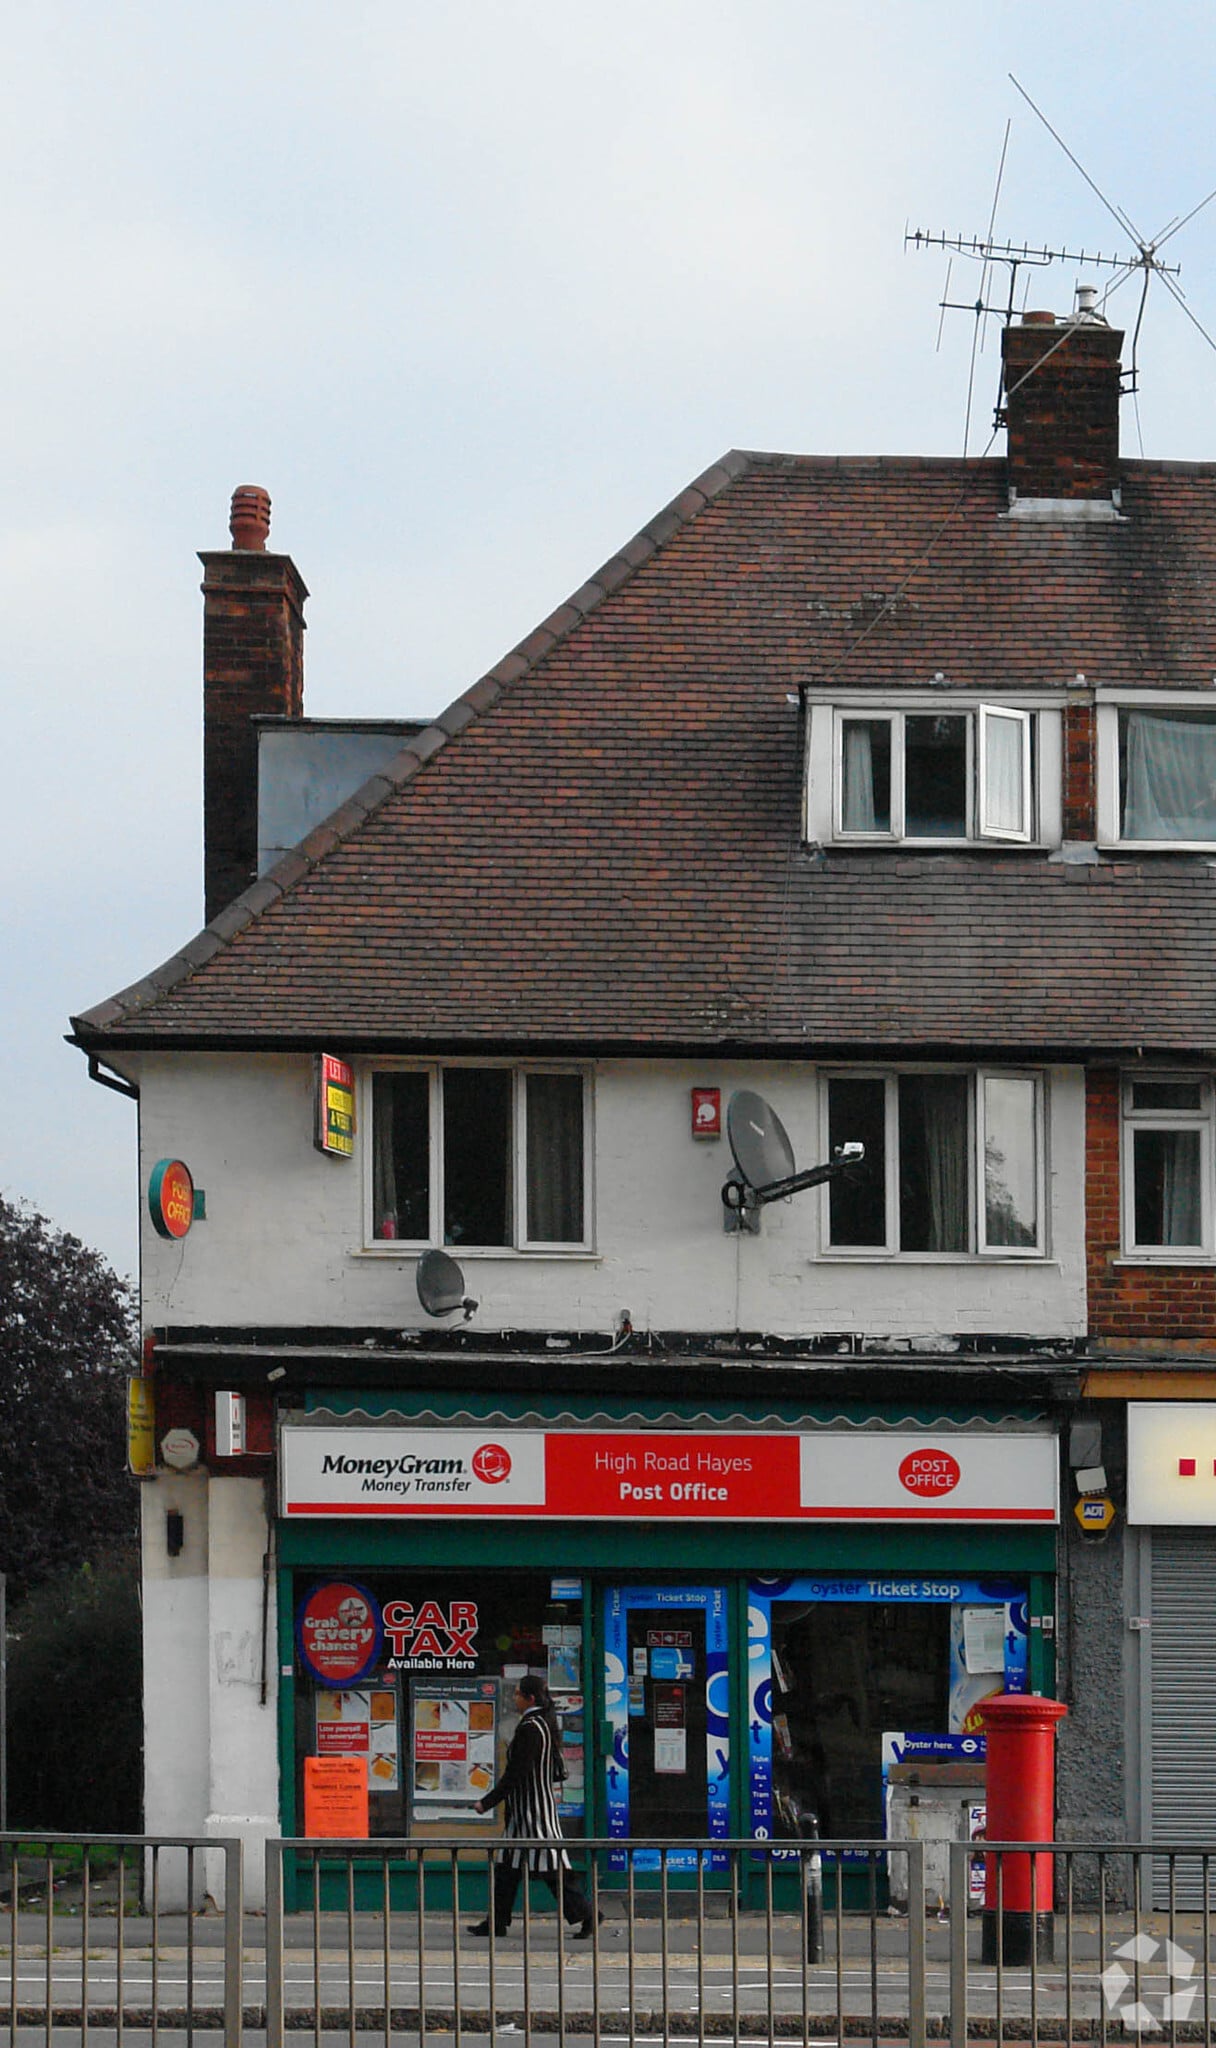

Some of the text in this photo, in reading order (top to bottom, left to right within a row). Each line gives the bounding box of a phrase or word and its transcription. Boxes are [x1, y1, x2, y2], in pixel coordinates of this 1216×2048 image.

[321, 1455, 463, 1478] MoneyGram
[595, 1452, 753, 1475] High Road Hayes
[912, 1459, 950, 1472] POST
[361, 1478, 472, 1495] Money Transfer
[905, 1474, 954, 1487] OFFICE
[620, 1482, 729, 1500] Post Office
[1083, 1504, 1105, 1518] ADT
[811, 1581, 960, 1599] oyster Ticket Stop
[656, 1592, 683, 1602] Ticket
[685, 1593, 707, 1604] Stop
[382, 1600, 478, 1629] CAR
[304, 1617, 340, 1628] Grab
[315, 1628, 373, 1644] every
[384, 1628, 478, 1657] TAX
[309, 1640, 358, 1651] chance
[387, 1658, 475, 1669] Available Here
[904, 1740, 932, 1750] Oyster
[609, 1801, 626, 1809] Tube
[711, 1801, 728, 1809] Tube
[611, 1819, 624, 1827] Bus
[712, 1819, 725, 1827] Bus
[712, 1854, 726, 1862] DLR
